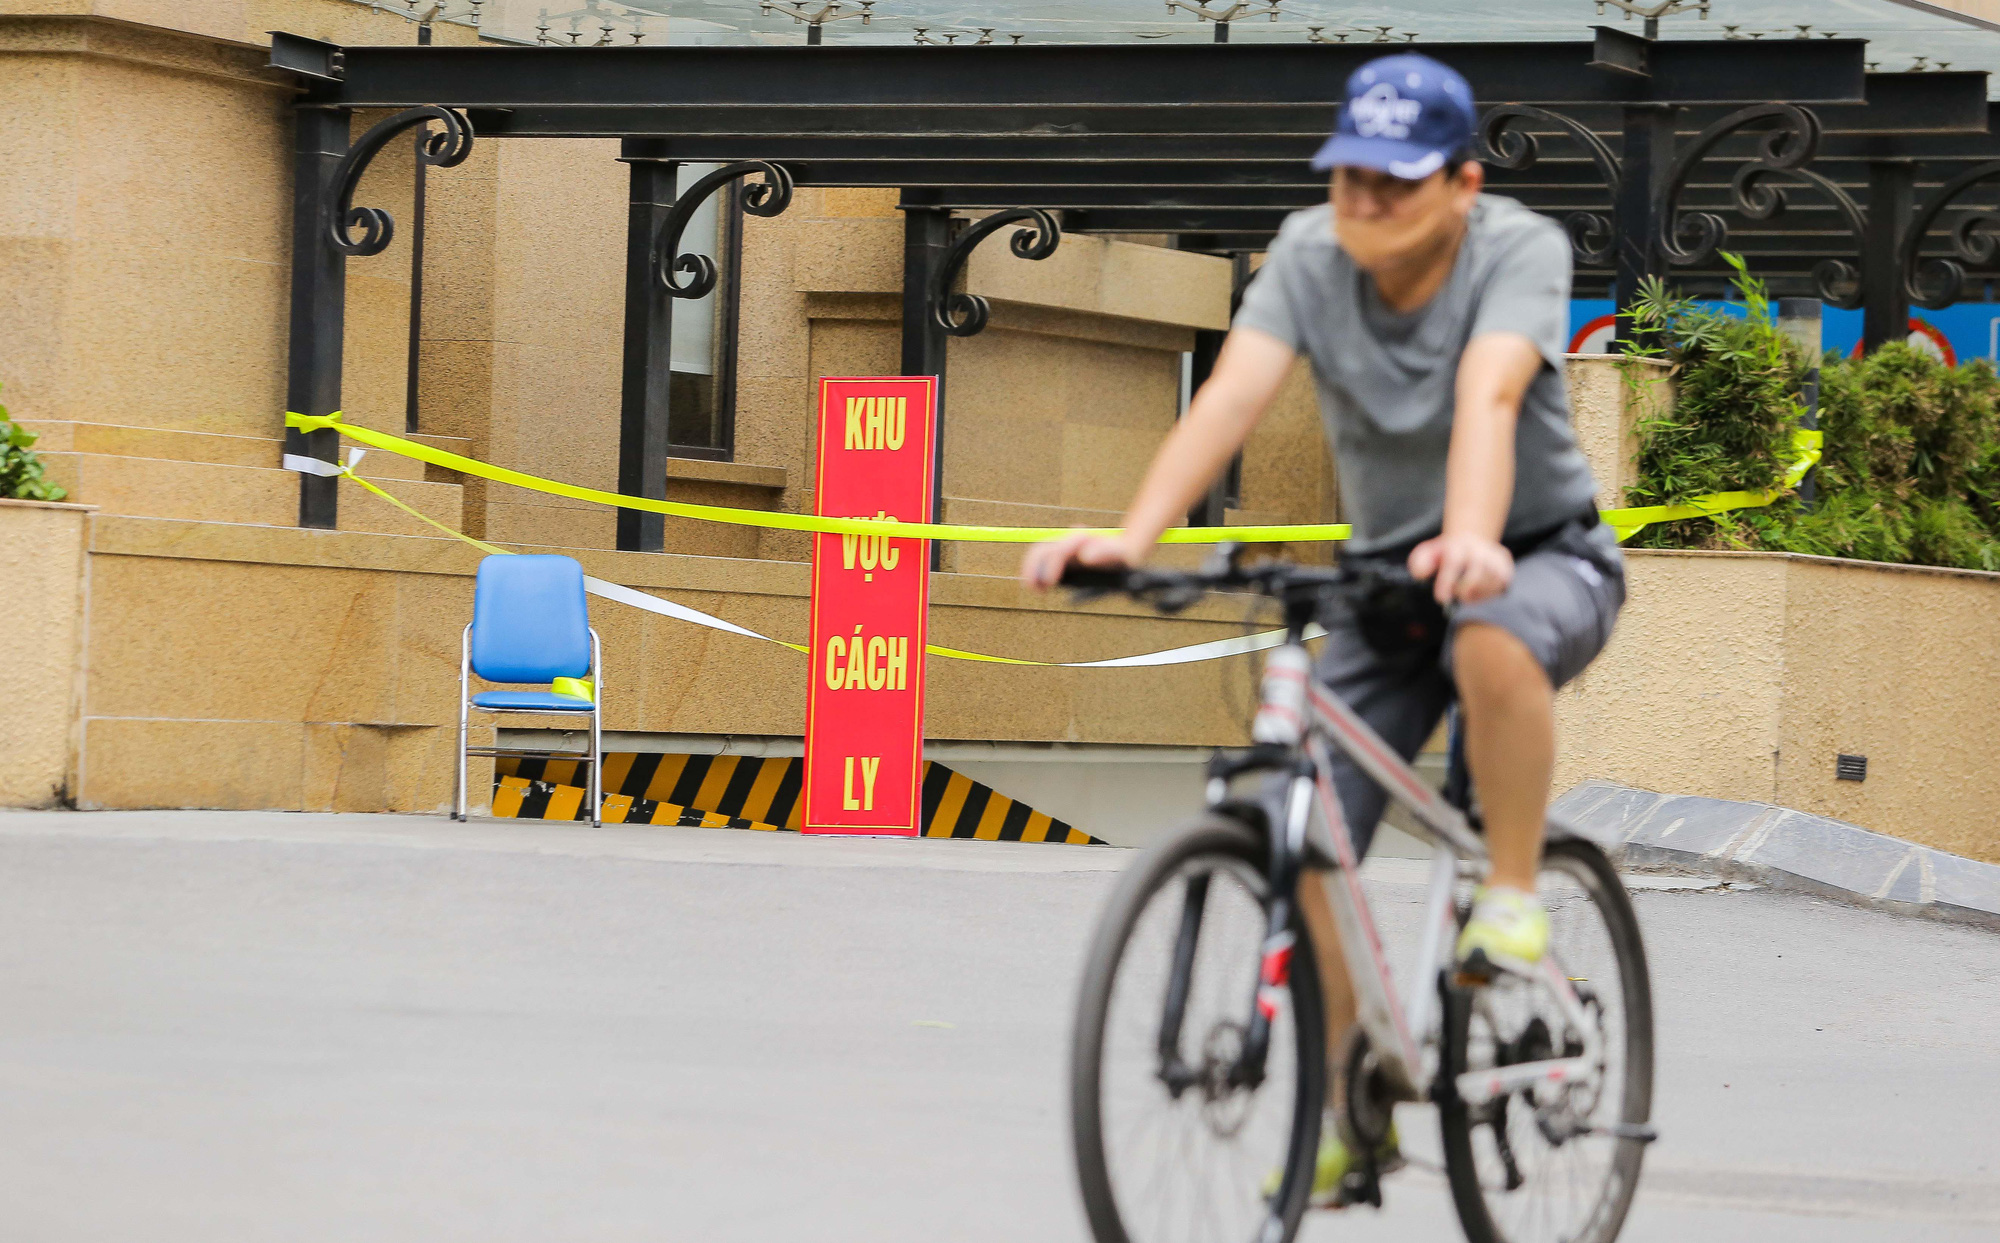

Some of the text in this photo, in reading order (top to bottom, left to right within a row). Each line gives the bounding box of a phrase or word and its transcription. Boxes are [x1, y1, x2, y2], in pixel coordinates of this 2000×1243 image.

[844, 396, 907, 451] KHU
[841, 510, 900, 582] VỰC
[825, 624, 908, 691] CÁCH
[843, 756, 881, 811] LY
